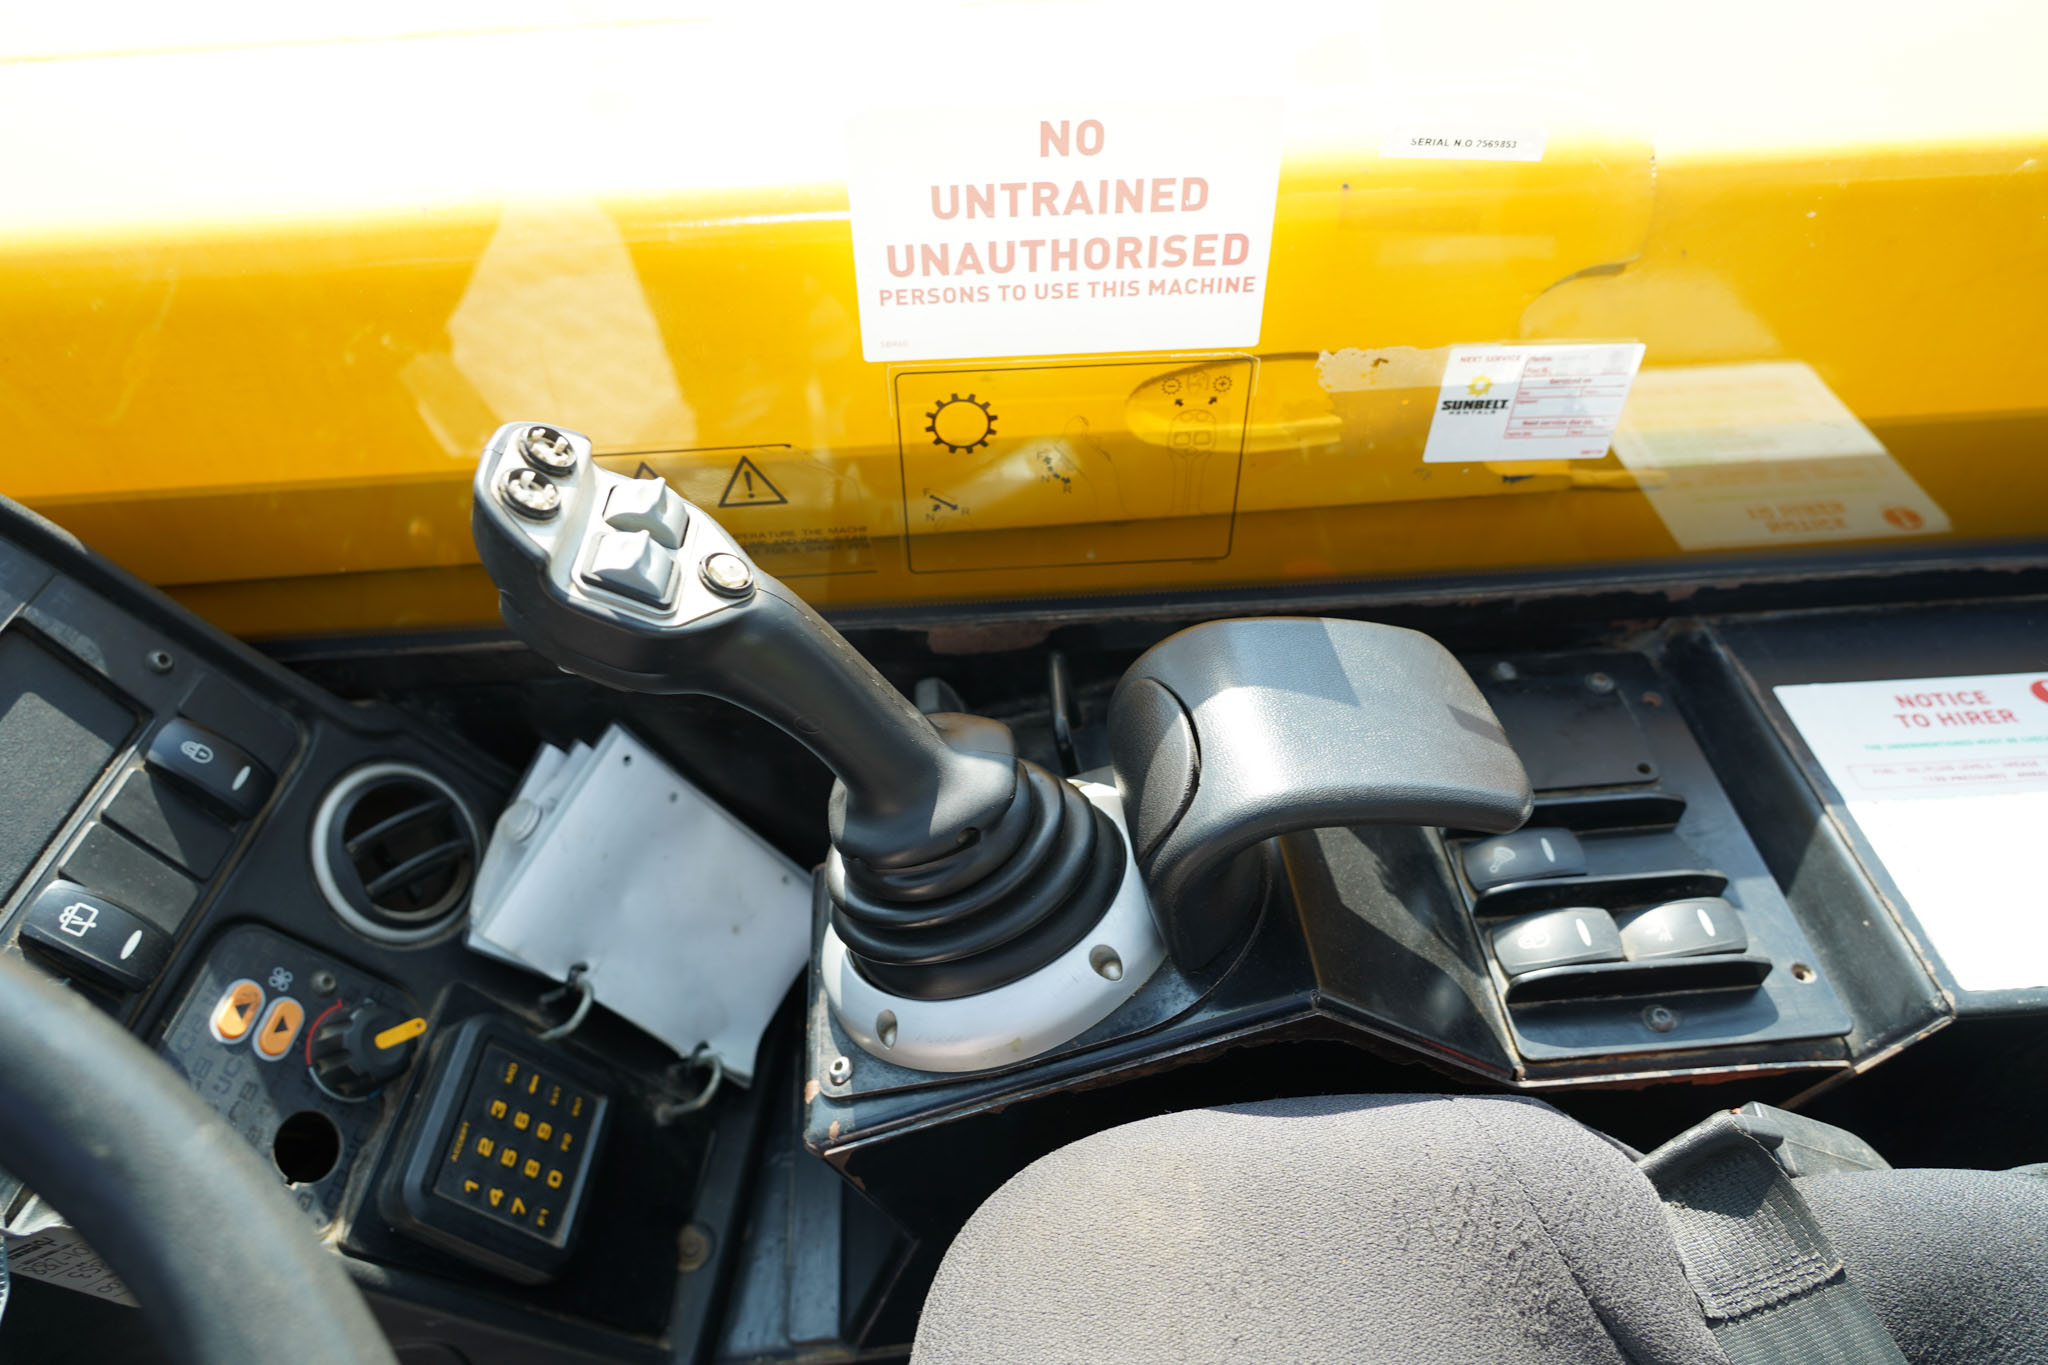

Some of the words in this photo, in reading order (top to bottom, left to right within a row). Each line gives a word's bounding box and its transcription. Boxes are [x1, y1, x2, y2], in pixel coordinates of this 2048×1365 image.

[1039, 119, 1105, 157] NO
[1410, 137, 1449, 147] SERIAL
[930, 176, 1210, 220] UNTRAINED
[886, 233, 1251, 278] UNAUTHORISED
[879, 283, 990, 306] PERSONS
[998, 284, 1026, 301] TO
[1034, 282, 1080, 300] USE
[1088, 279, 1140, 298] THIS
[1148, 275, 1257, 297] MACHINE
[1441, 399, 1509, 411] SUNBELT
[1893, 690, 1992, 709] NOTICE
[1893, 712, 1931, 730] TO
[1936, 709, 2020, 728] HIRER
[464, 1179, 479, 1192] 1
[476, 1137, 495, 1157] 2
[490, 1100, 507, 1119] 3
[489, 1188, 504, 1207] 4
[500, 1148, 517, 1168] 5
[513, 1111, 530, 1130] 6
[511, 1197, 526, 1215] 7
[524, 1159, 541, 1178] 8
[537, 1121, 552, 1141] 9
[547, 1169, 563, 1189] 0
